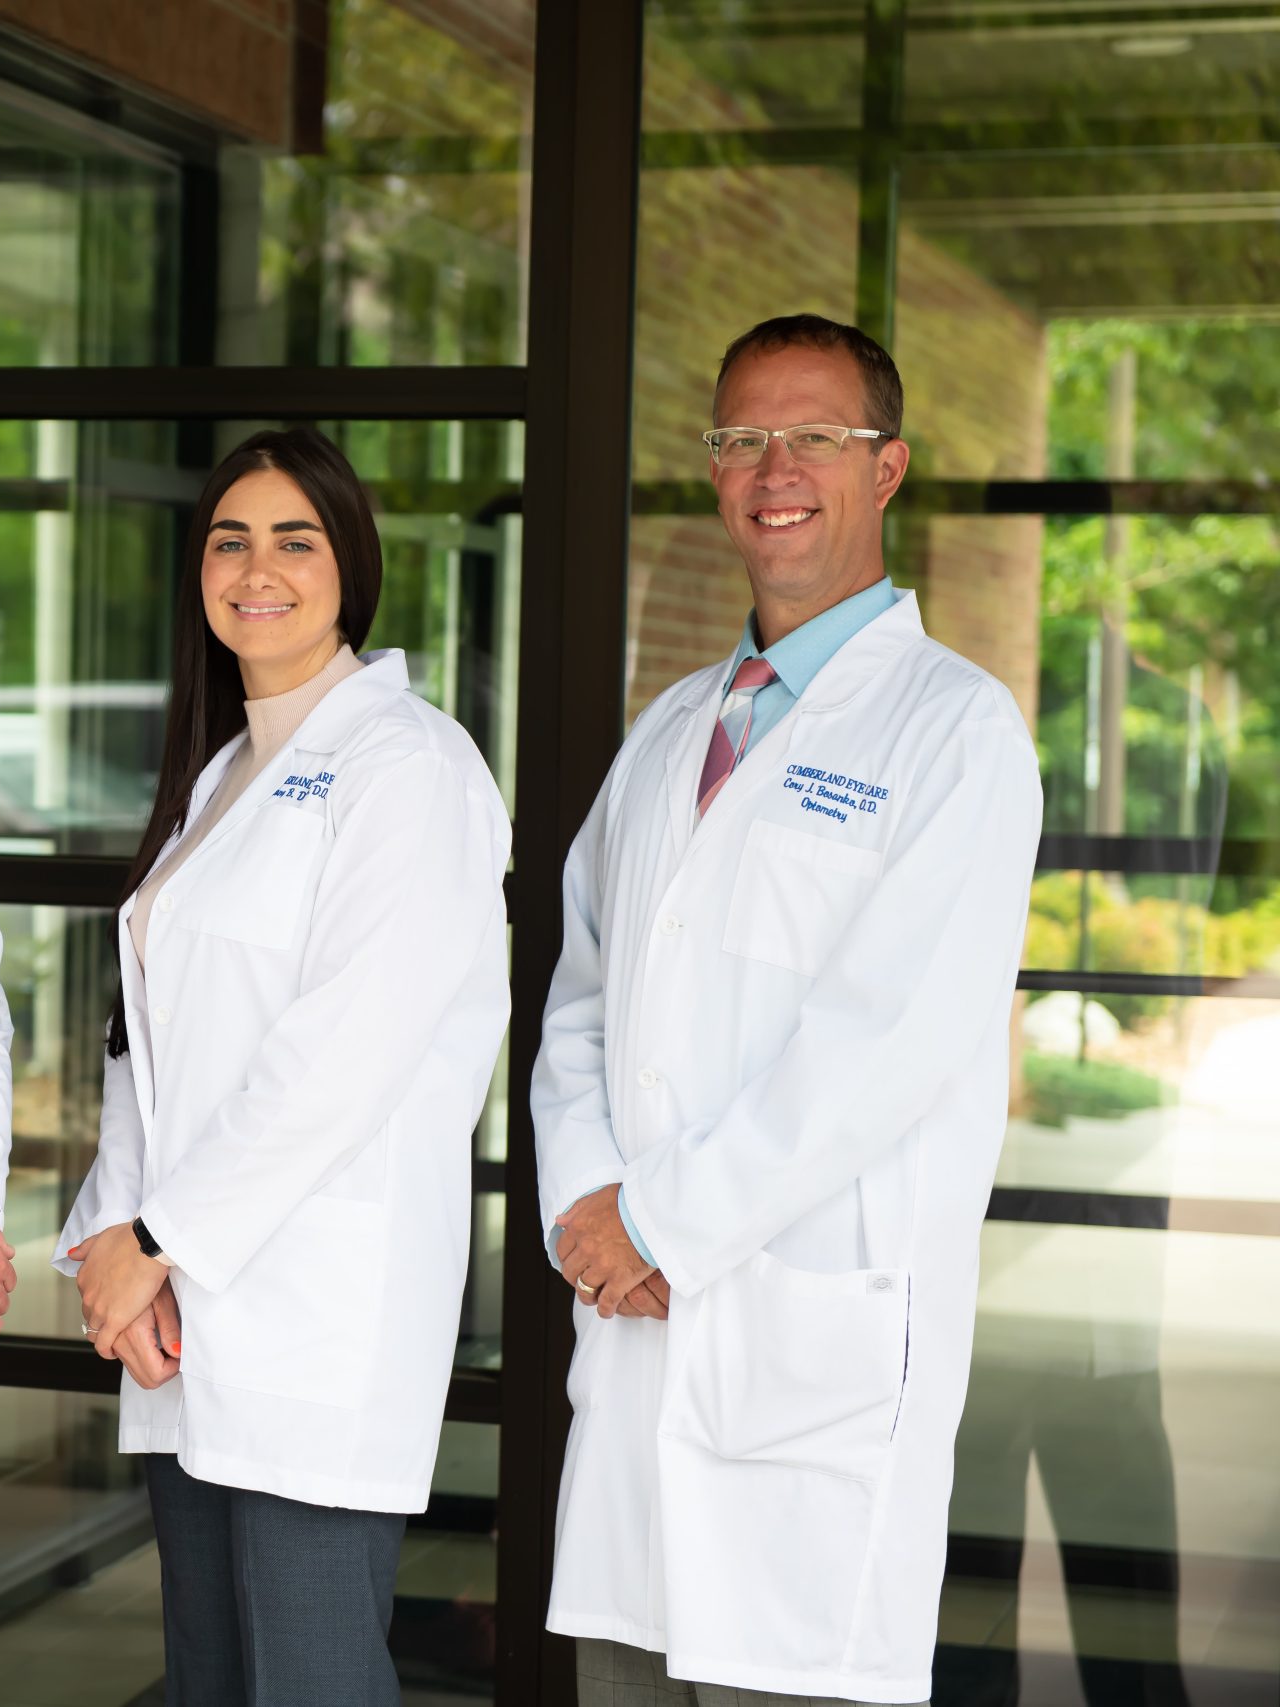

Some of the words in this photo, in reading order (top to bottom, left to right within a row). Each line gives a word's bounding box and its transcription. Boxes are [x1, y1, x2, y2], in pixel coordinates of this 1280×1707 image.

[783, 777, 804, 792] Cory
[805, 782, 814, 793] J.
[816, 785, 857, 809] Bosanko,
[859, 799, 877, 814] O.D.
[786, 764, 847, 787] CUMBERLAND
[846, 778, 867, 795] EYE
[864, 784, 889, 800] CARE
[801, 797, 848, 823] Optometry
